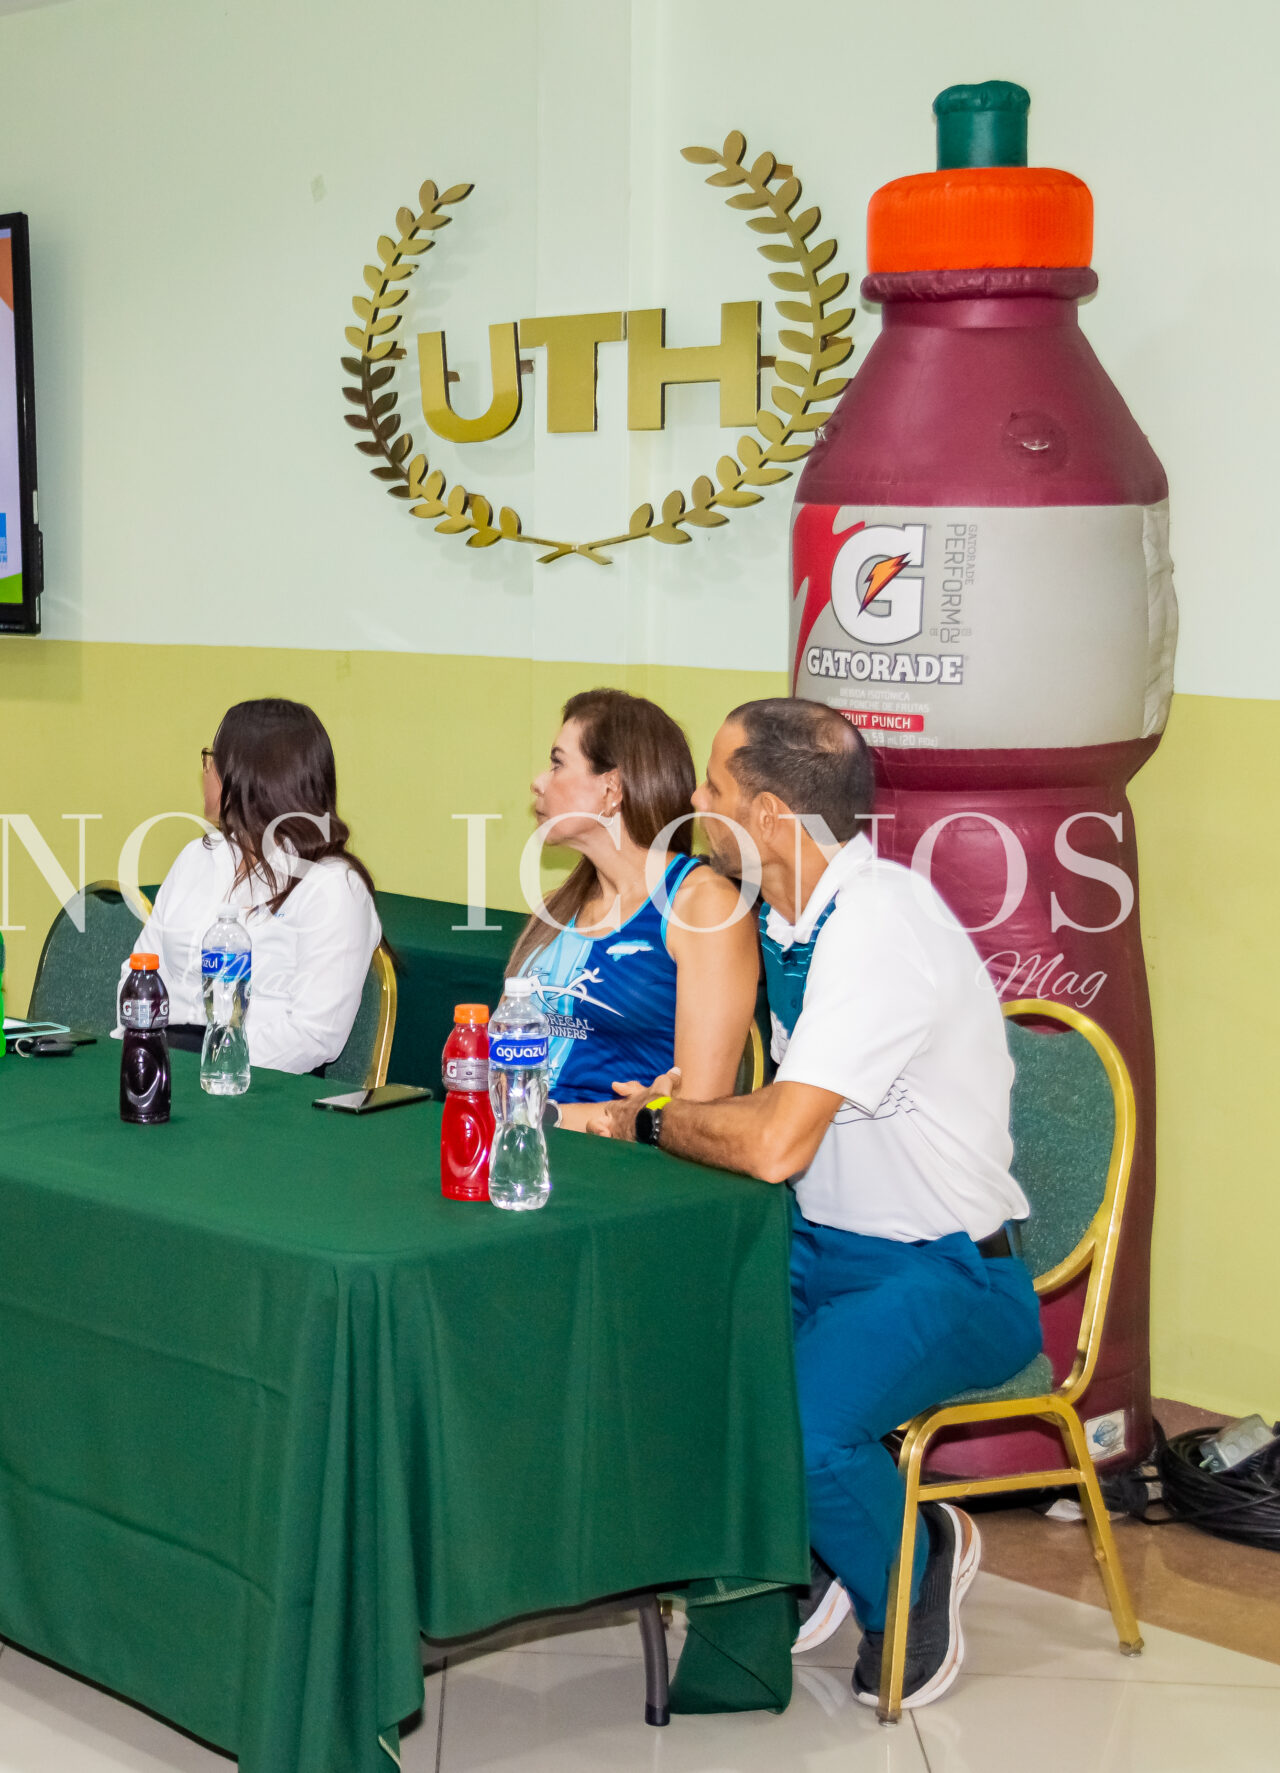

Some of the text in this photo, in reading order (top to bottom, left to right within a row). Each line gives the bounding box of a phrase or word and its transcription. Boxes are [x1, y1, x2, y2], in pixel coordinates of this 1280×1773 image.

[417, 300, 762, 444] UTH
[964, 524, 978, 586] GATORADE
[831, 523, 926, 646] G
[940, 523, 967, 625] PERFORM
[806, 646, 964, 685] GATORADE
[871, 715, 911, 729] PUNCH
[895, 702, 930, 713] FRUTAS
[122, 1000, 132, 1016] G
[496, 1040, 547, 1062] aguazul
[446, 1061, 457, 1078] G
